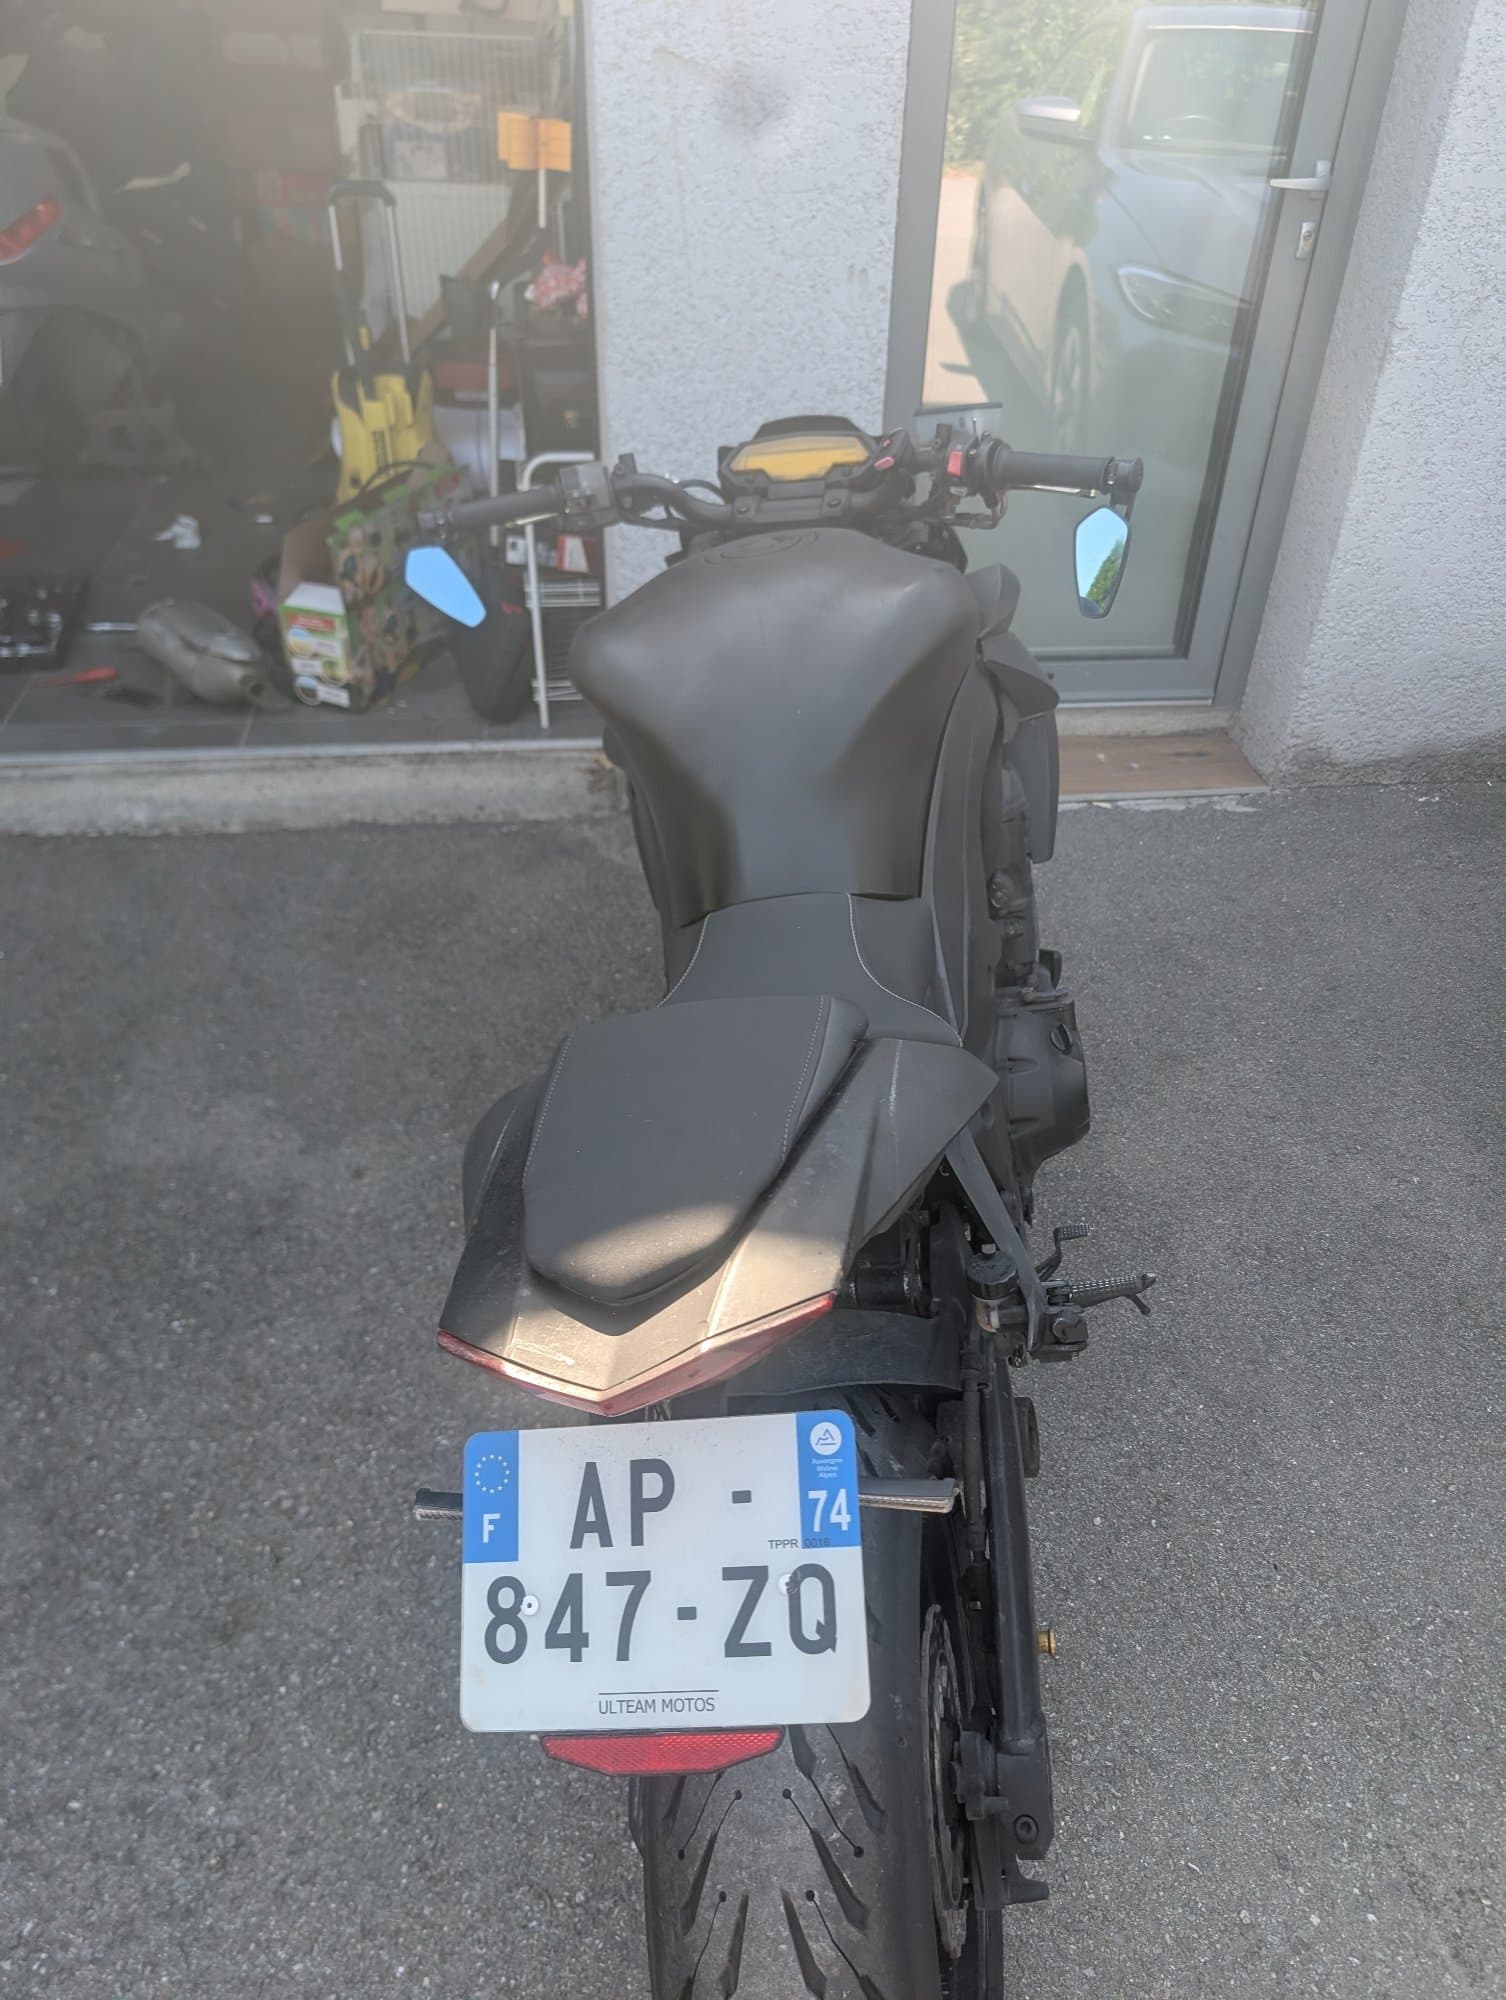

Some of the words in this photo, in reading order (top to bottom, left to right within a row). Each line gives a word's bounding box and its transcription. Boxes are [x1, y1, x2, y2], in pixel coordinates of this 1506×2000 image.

[570, 1458, 675, 1549] AP
[808, 1488, 851, 1532] 74
[482, 1513, 500, 1543] F
[768, 1538, 799, 1549] TPPR
[484, 1563, 837, 1665] 847-ZQ
[598, 1698, 657, 1714] ULTEAM
[661, 1697, 716, 1713] MOTOS
